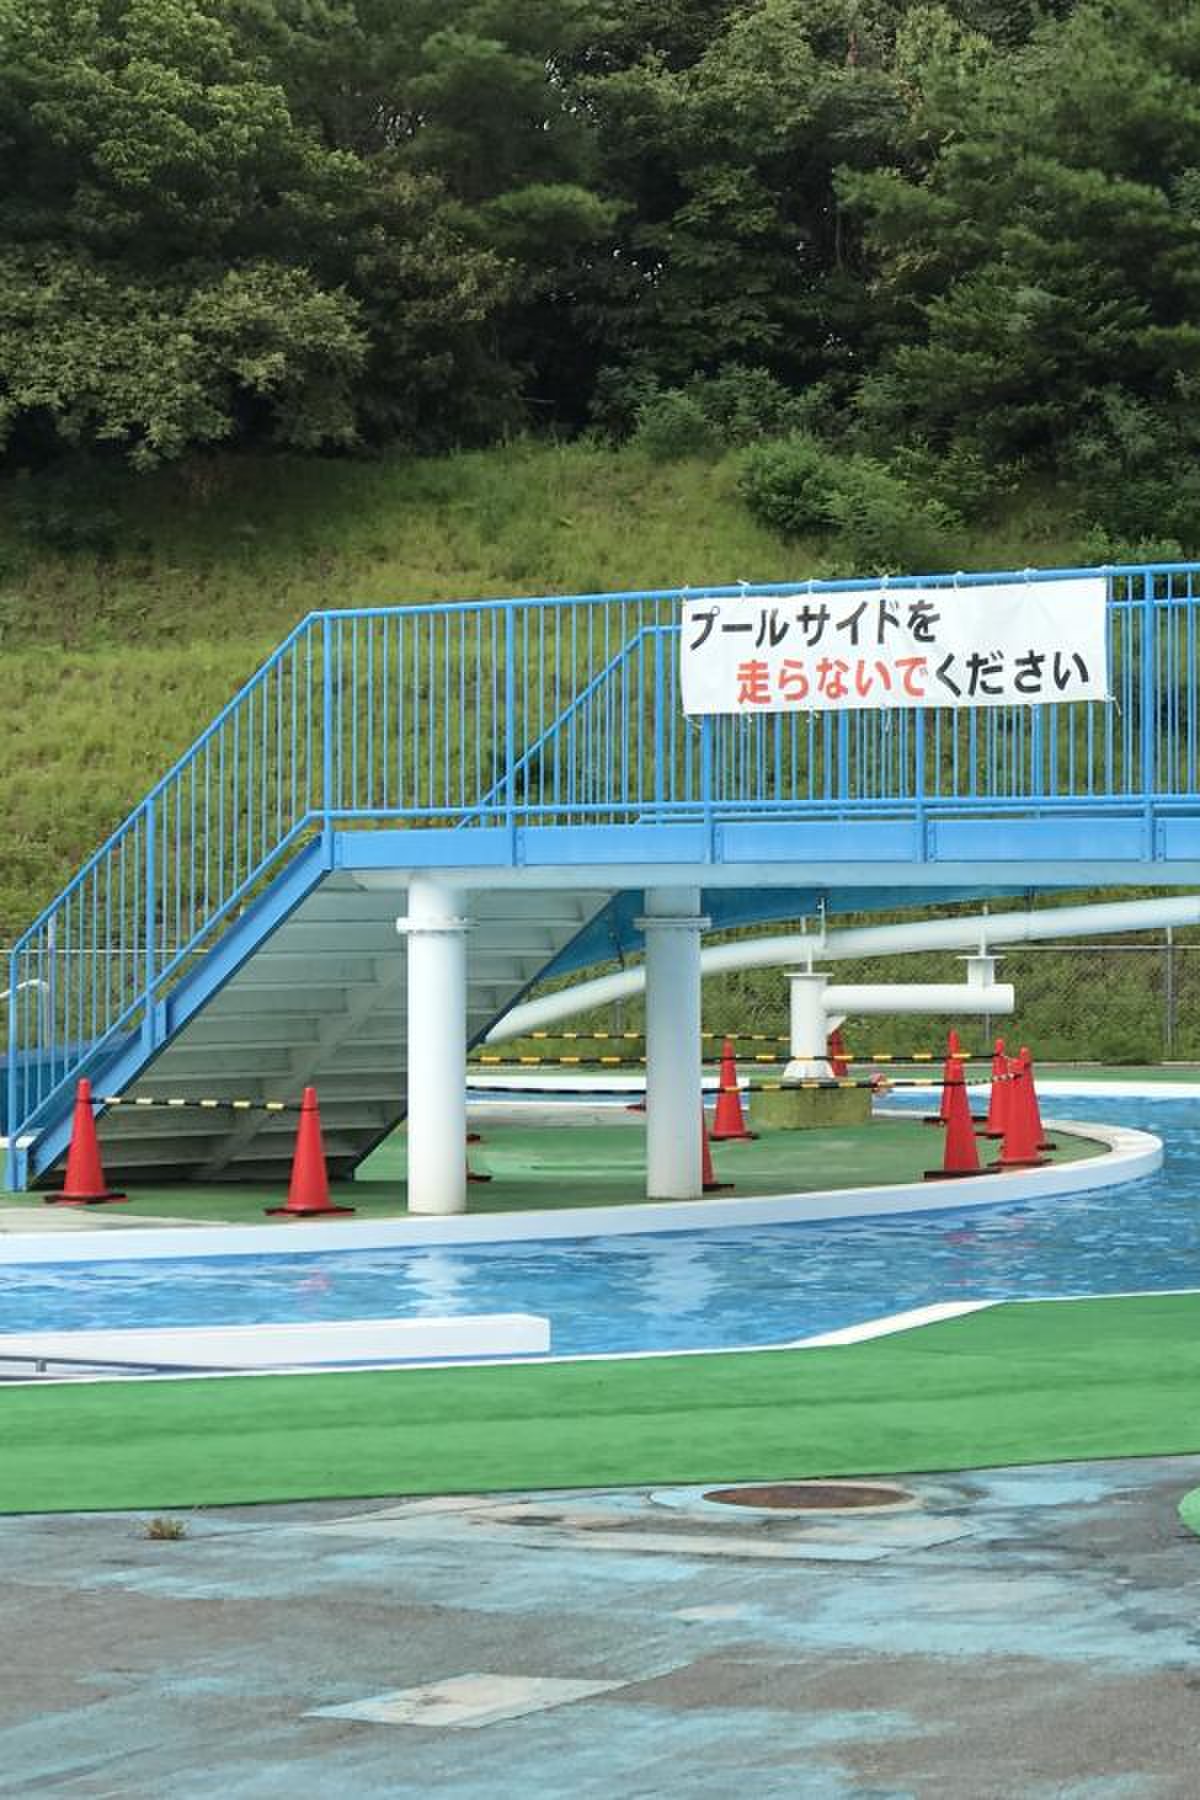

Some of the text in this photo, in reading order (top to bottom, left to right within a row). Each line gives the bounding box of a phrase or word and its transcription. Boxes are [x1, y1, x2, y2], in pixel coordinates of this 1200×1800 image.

[690, 599, 941, 650] プールサイドを
[736, 650, 1089, 704] 走らないでください
